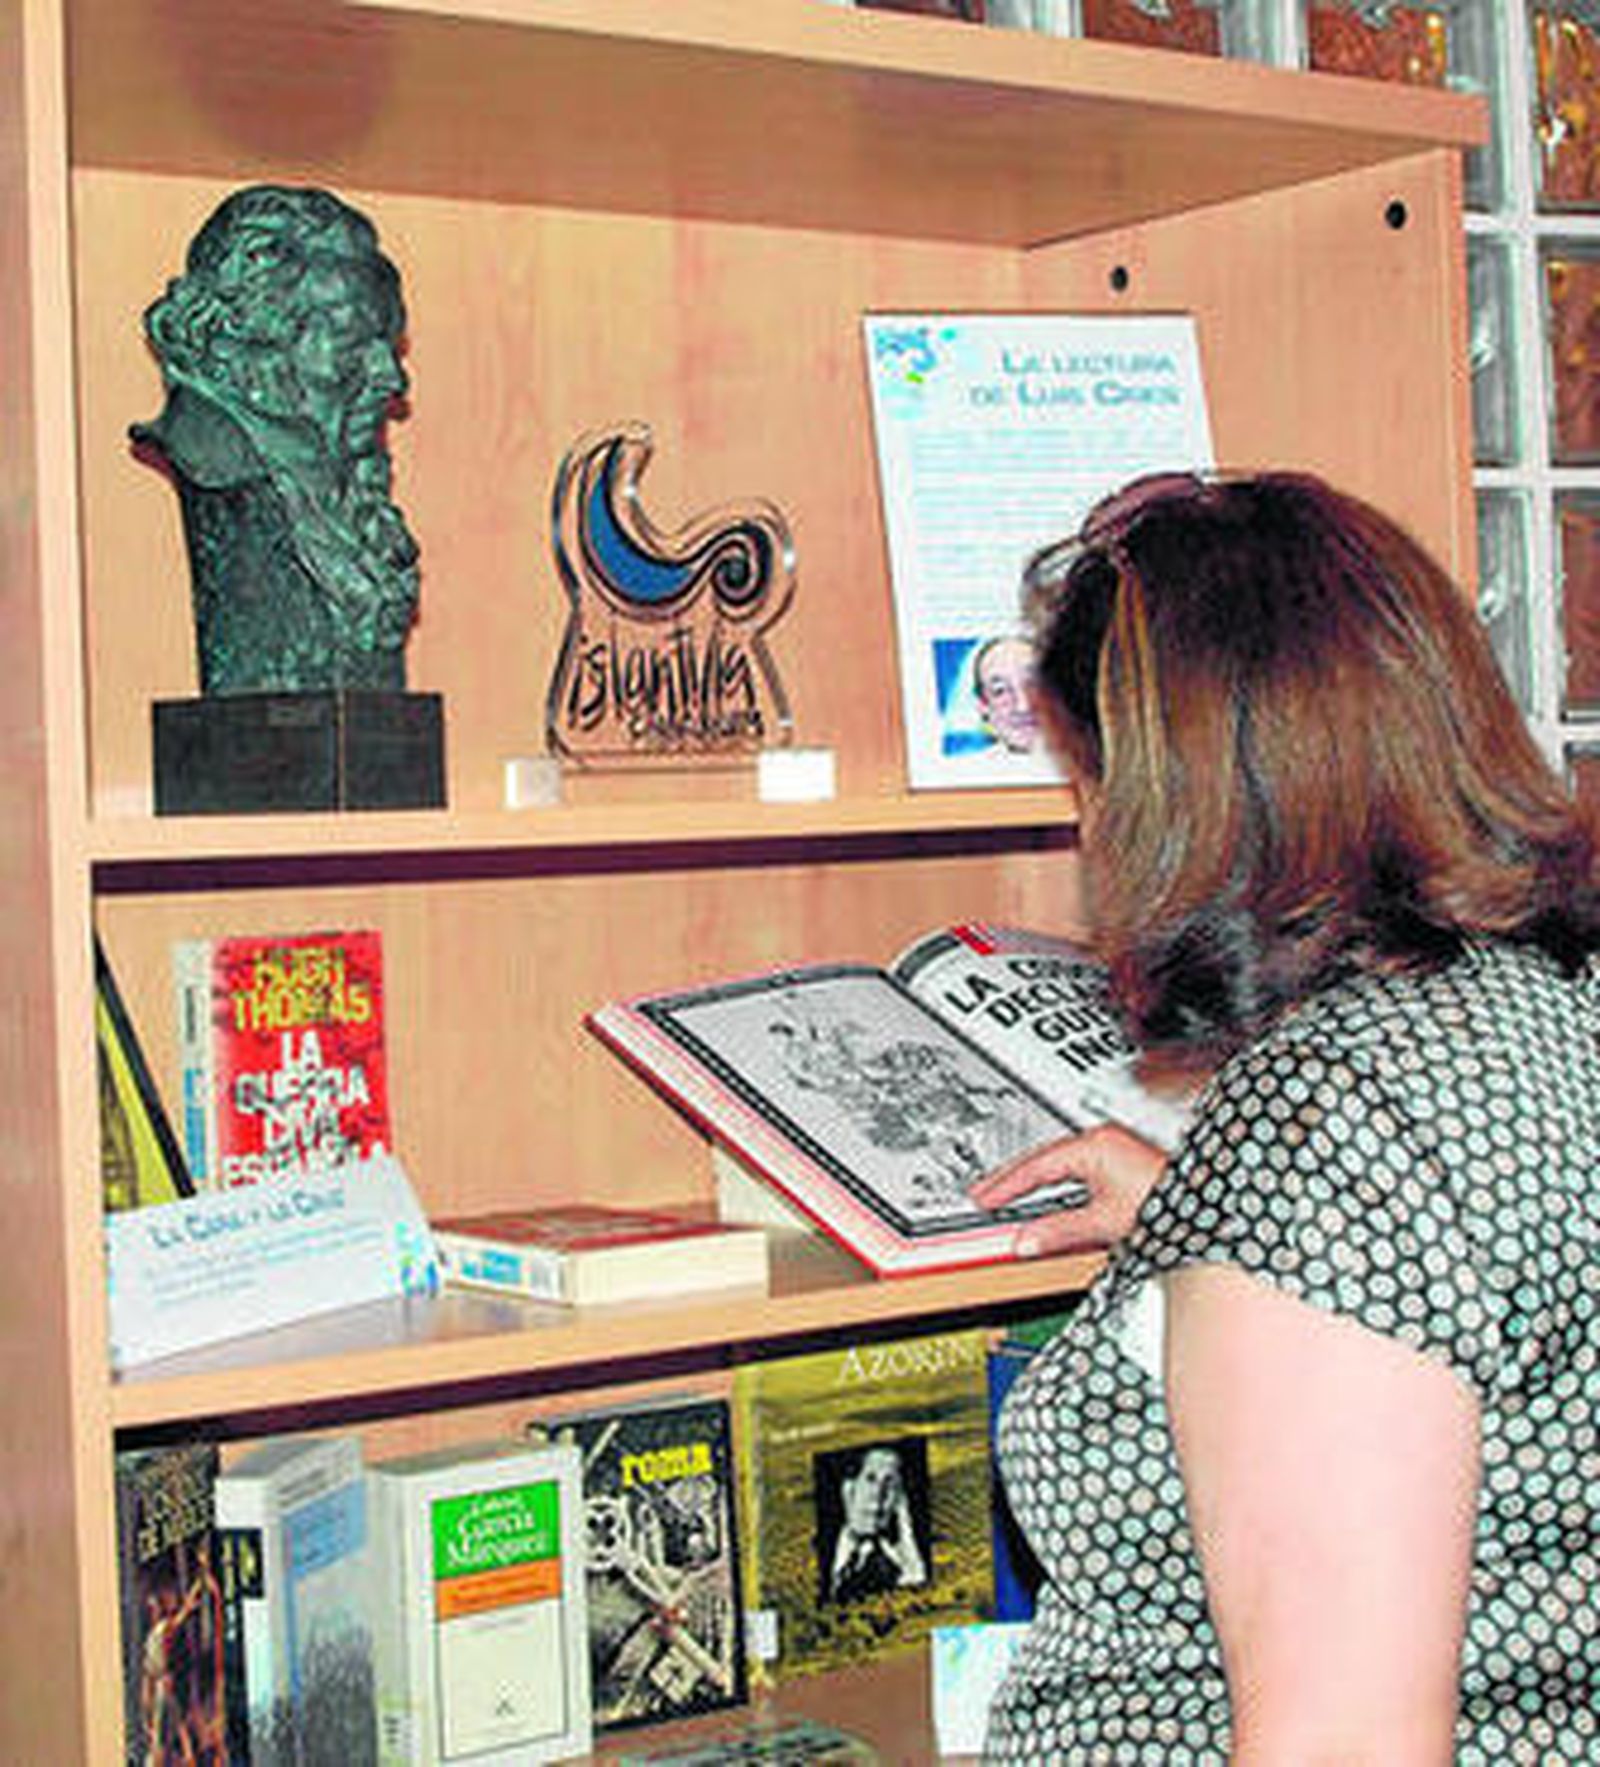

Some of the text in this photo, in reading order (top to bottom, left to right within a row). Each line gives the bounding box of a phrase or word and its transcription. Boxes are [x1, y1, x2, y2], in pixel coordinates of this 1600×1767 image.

[230, 982, 372, 1031] THOMAS
[943, 973, 1004, 1014] LA
[280, 1030, 324, 1071] LA
